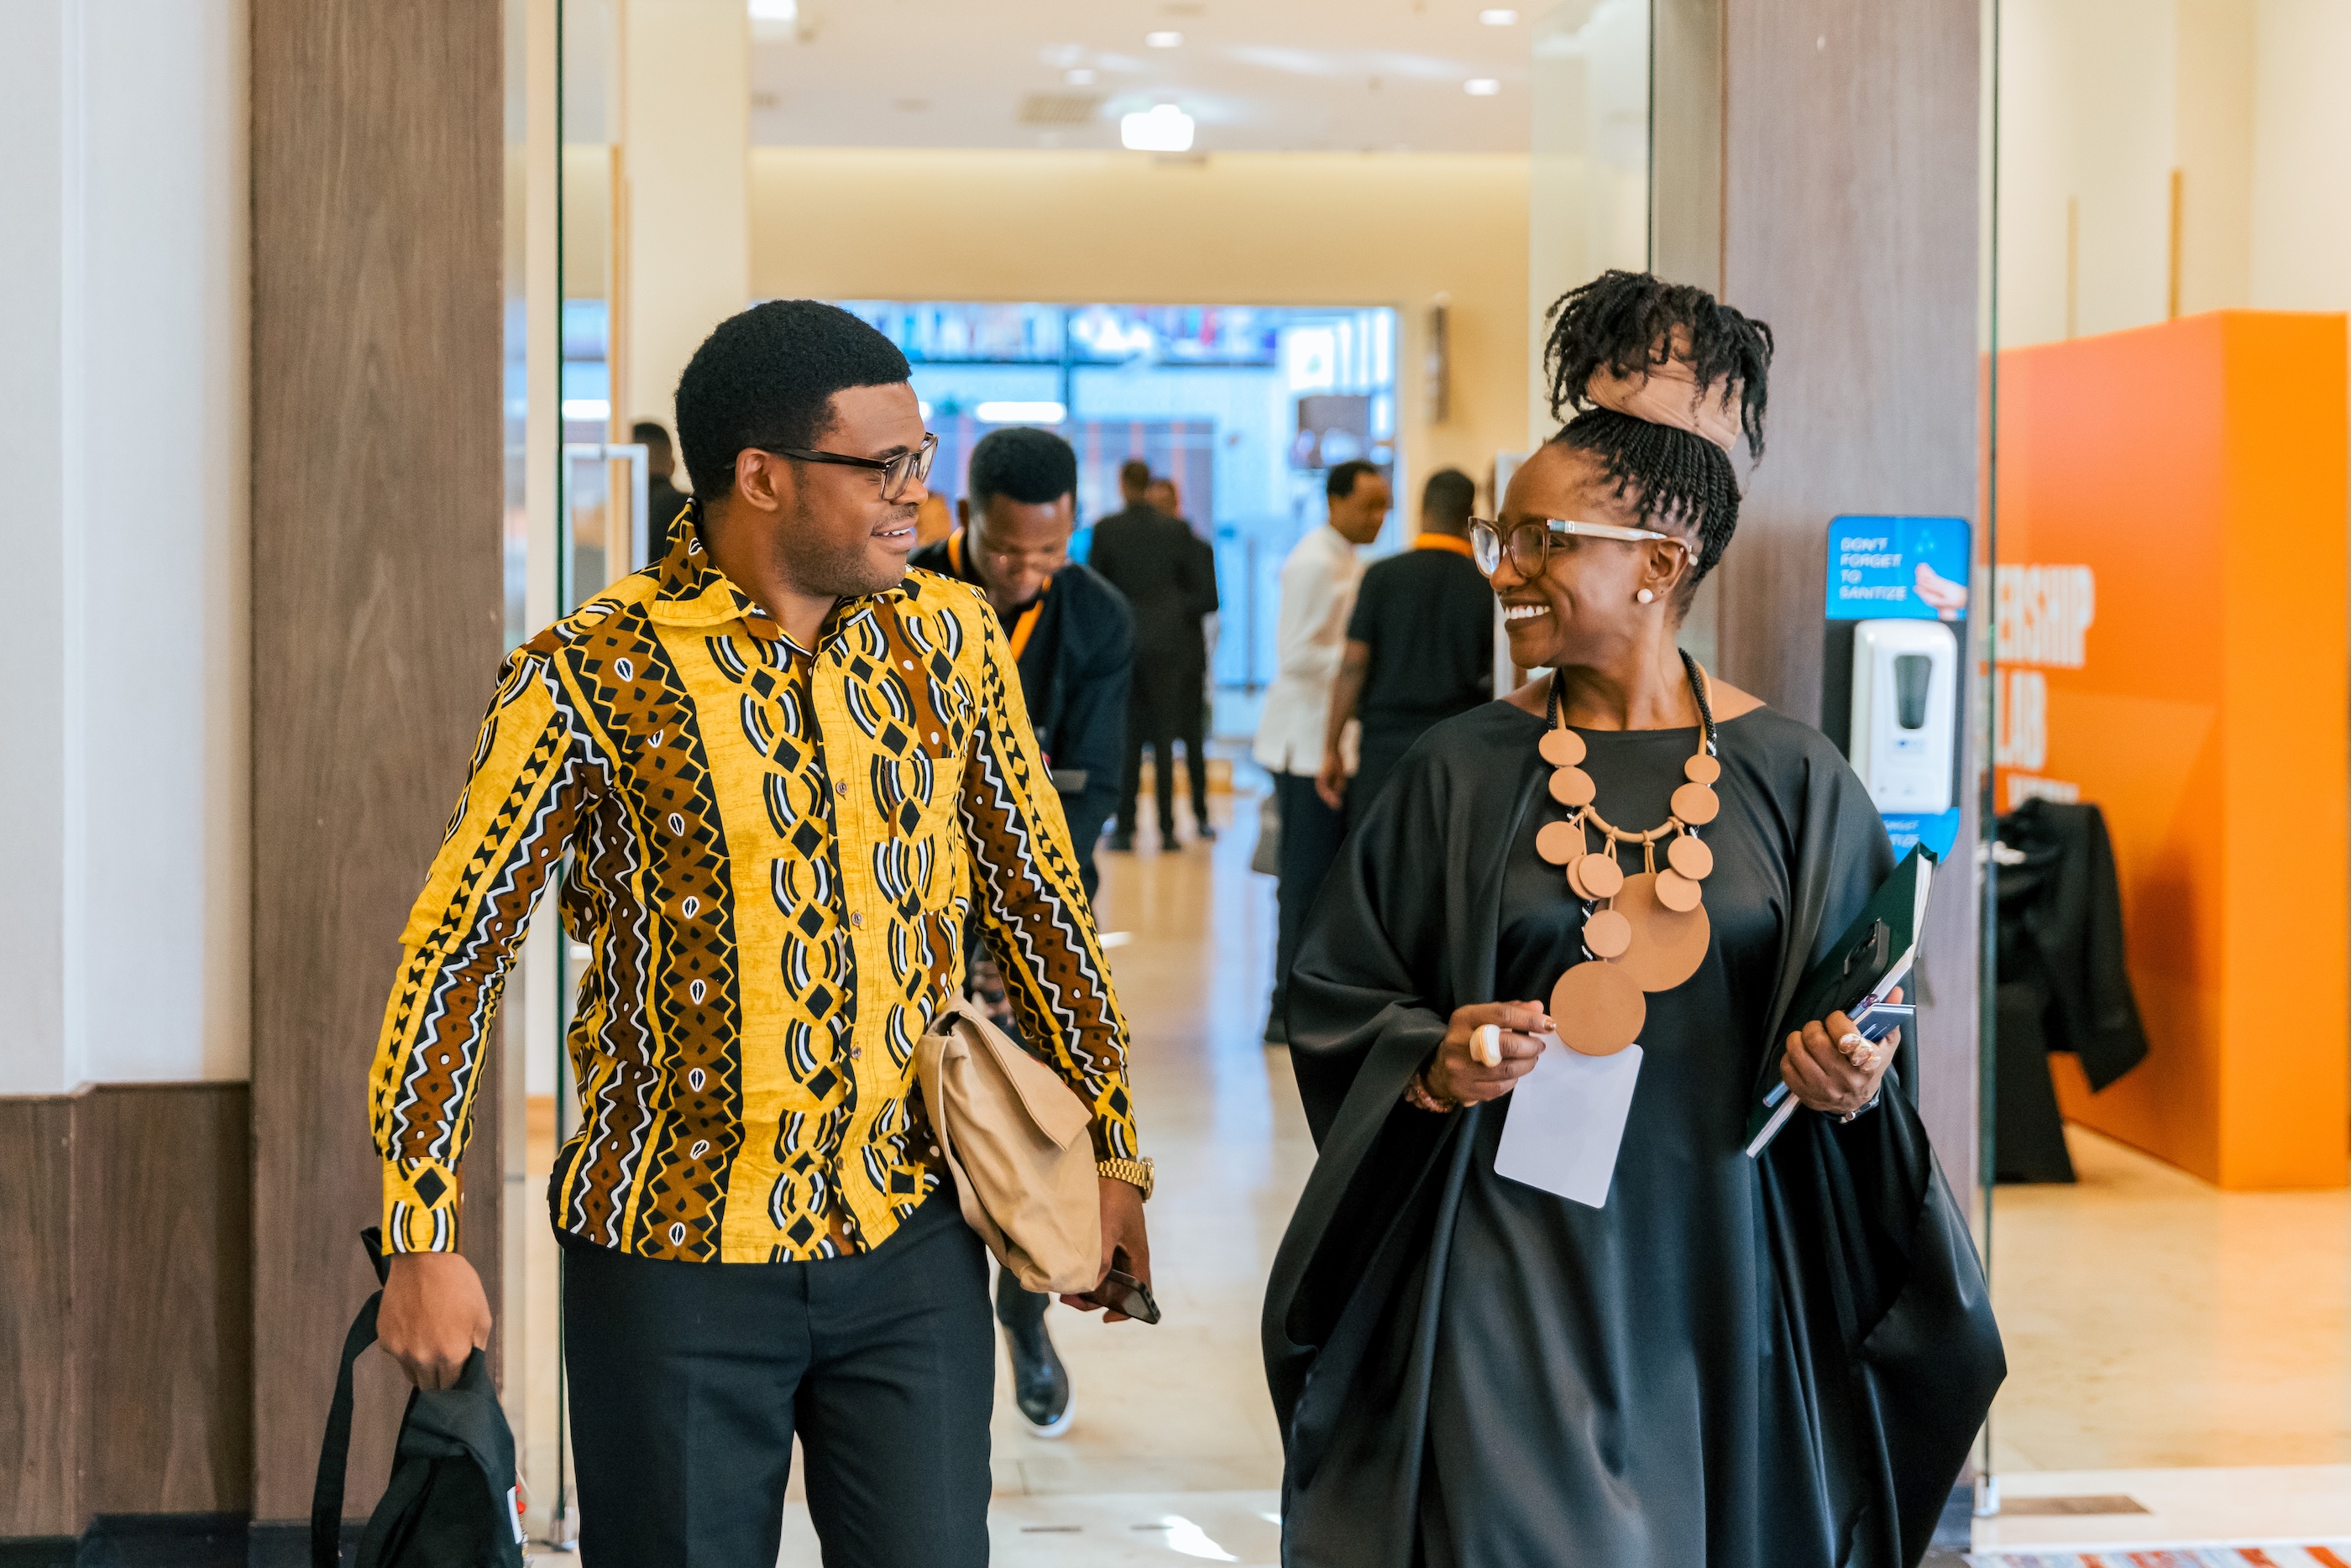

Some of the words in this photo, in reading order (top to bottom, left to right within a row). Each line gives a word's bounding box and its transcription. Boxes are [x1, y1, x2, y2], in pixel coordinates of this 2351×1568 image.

[1840, 537, 1888, 552] DON'T
[1840, 553, 1903, 568] FORGET
[1840, 569, 1862, 584] TO
[1839, 585, 1908, 601] SANITIZE
